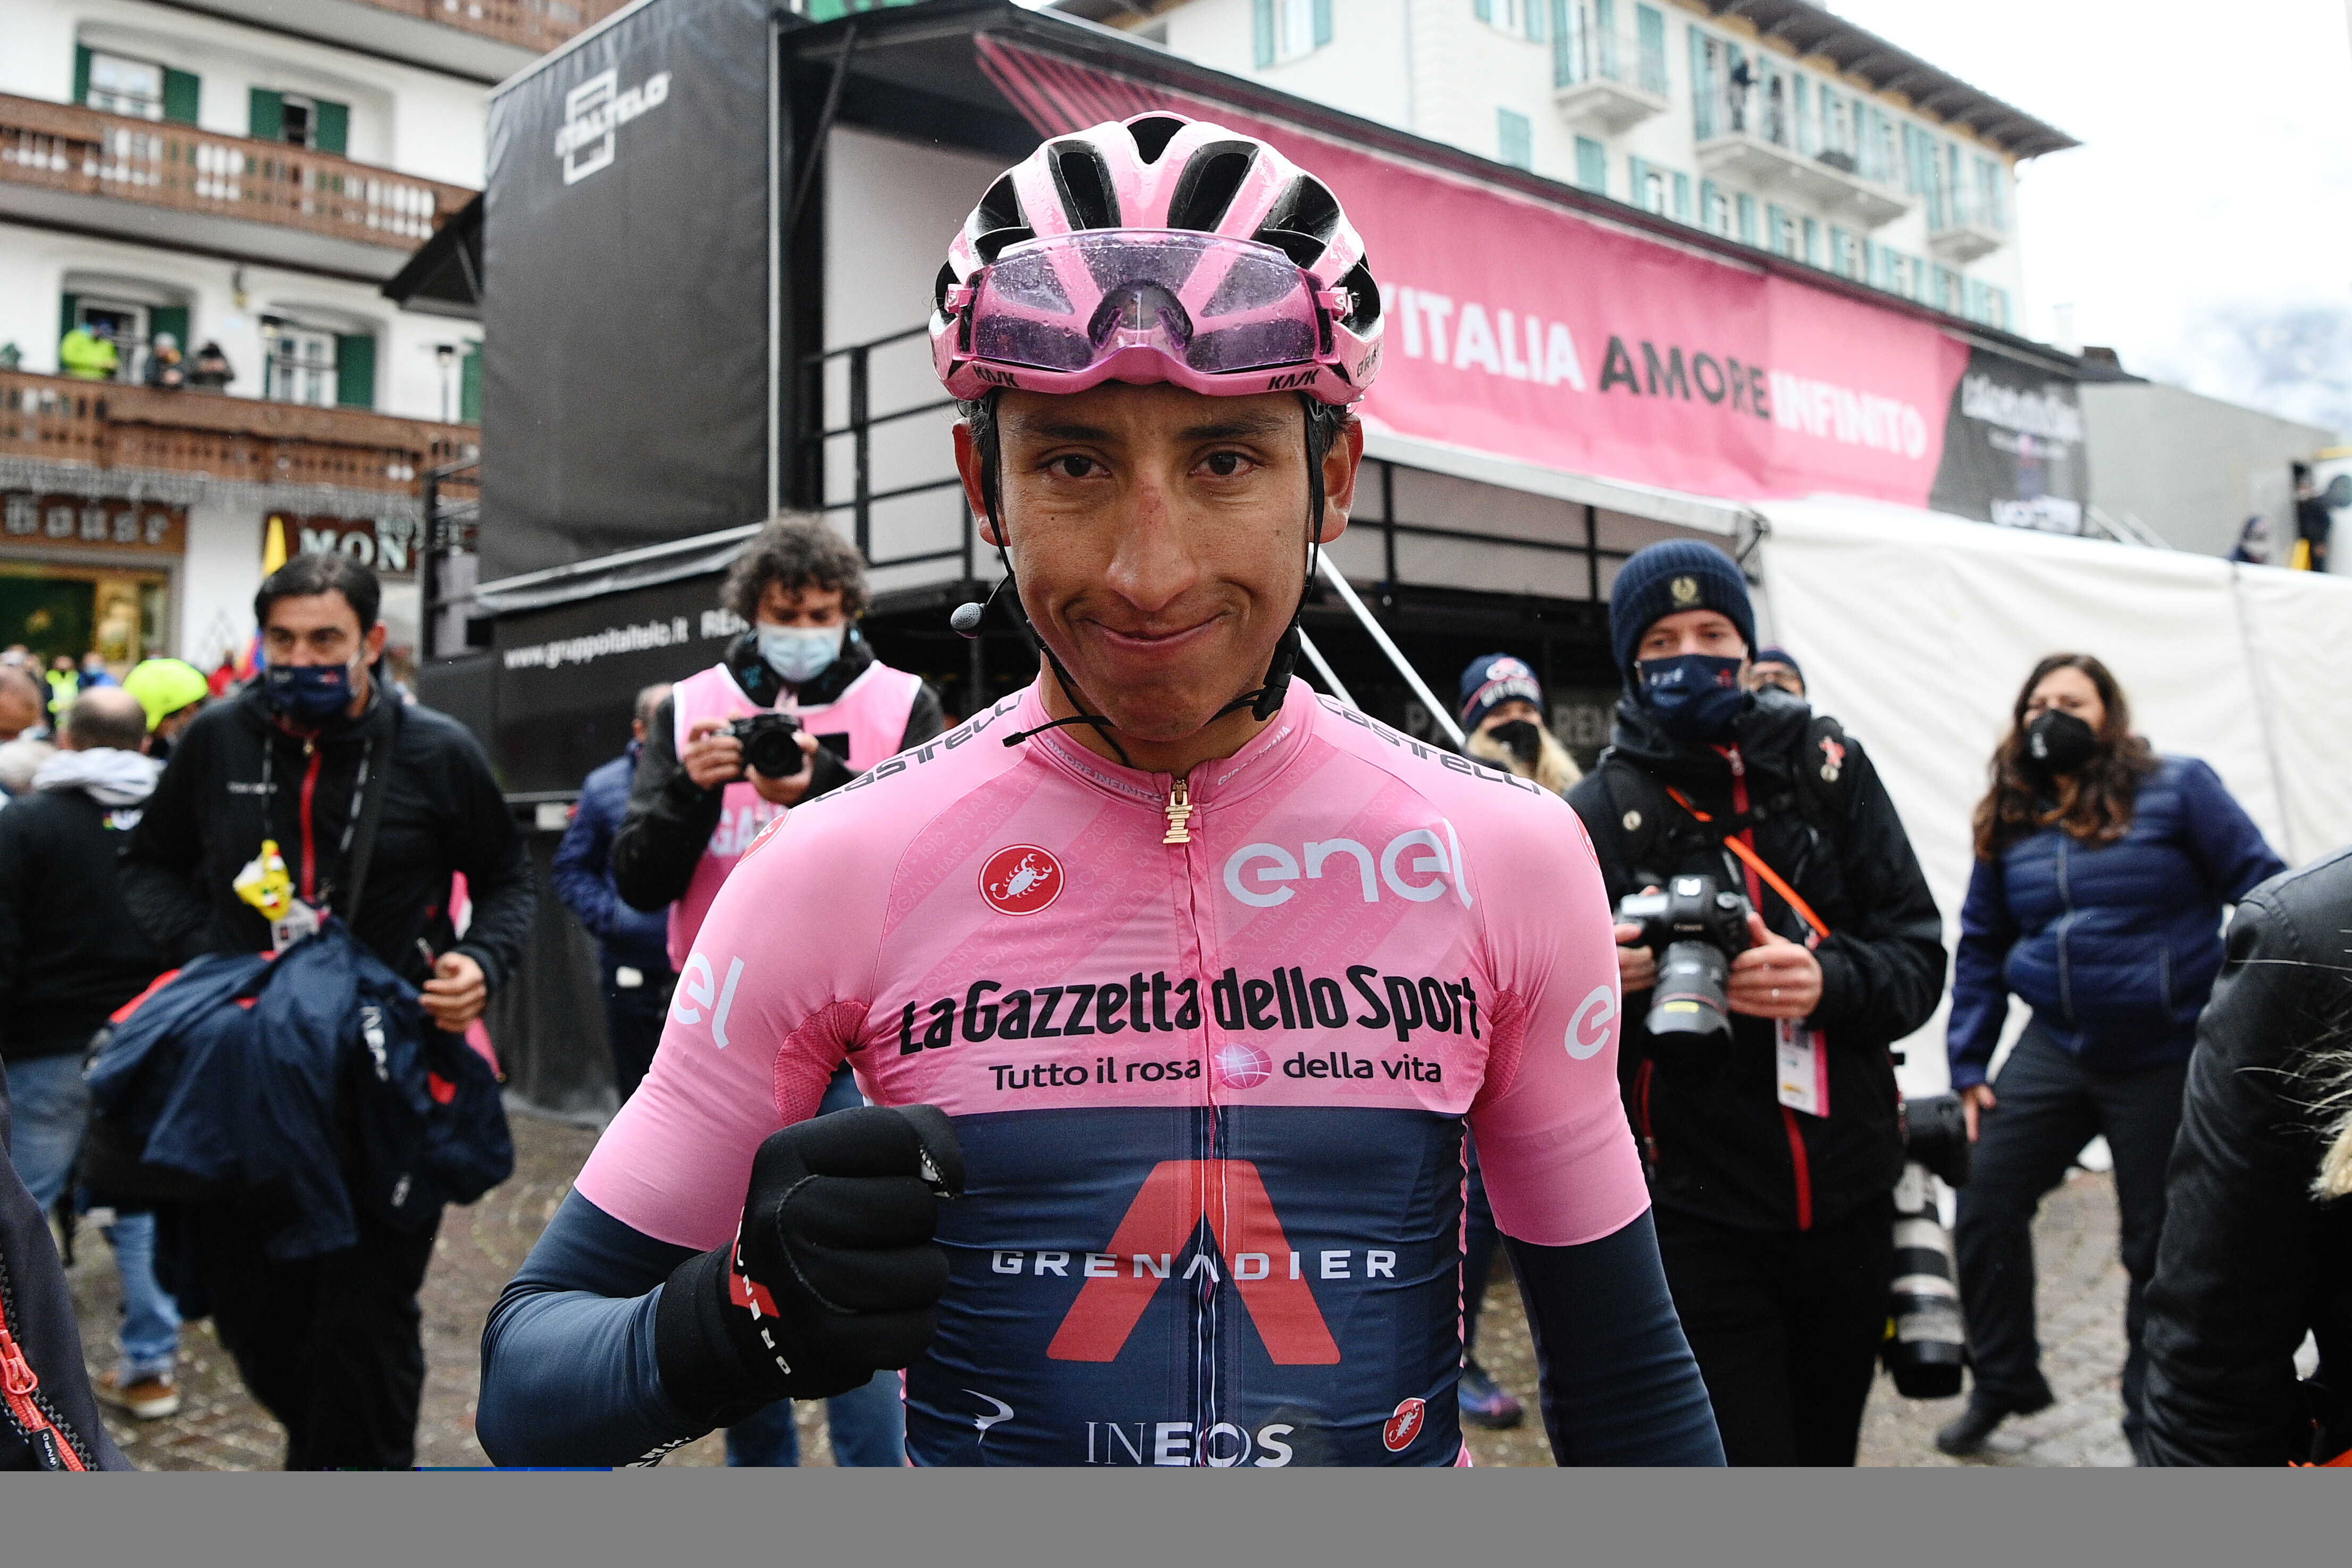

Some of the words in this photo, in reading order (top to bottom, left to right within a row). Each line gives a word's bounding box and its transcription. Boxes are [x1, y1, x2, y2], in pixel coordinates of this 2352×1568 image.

[1598, 334, 1771, 420] AMORE
[1769, 371, 1928, 459] INFINITO
[1046, 738, 1092, 774] AMORE
[930, 838, 973, 879] HART
[976, 800, 1012, 834] 2019
[1208, 789, 1276, 853] TONKOV
[1280, 752, 1318, 789] 1995
[1066, 820, 1146, 896] SCARPONI
[1223, 817, 1473, 910] enel
[1266, 892, 1336, 958] SARONNI
[899, 998, 957, 1056] La
[961, 972, 1201, 1043] Gazzetta
[1211, 966, 1349, 1031] dello
[1346, 965, 1481, 1042] Sport
[1564, 971, 1622, 1060] e
[988, 1063, 1089, 1090] Tutto
[1097, 1057, 1118, 1084] il
[1126, 1059, 1201, 1082] rosa
[1282, 1051, 1374, 1079] della
[1380, 1053, 1441, 1083] vita
[992, 1249, 1397, 1283] GRENADIER
[1085, 1421, 1295, 1467] INEOS
